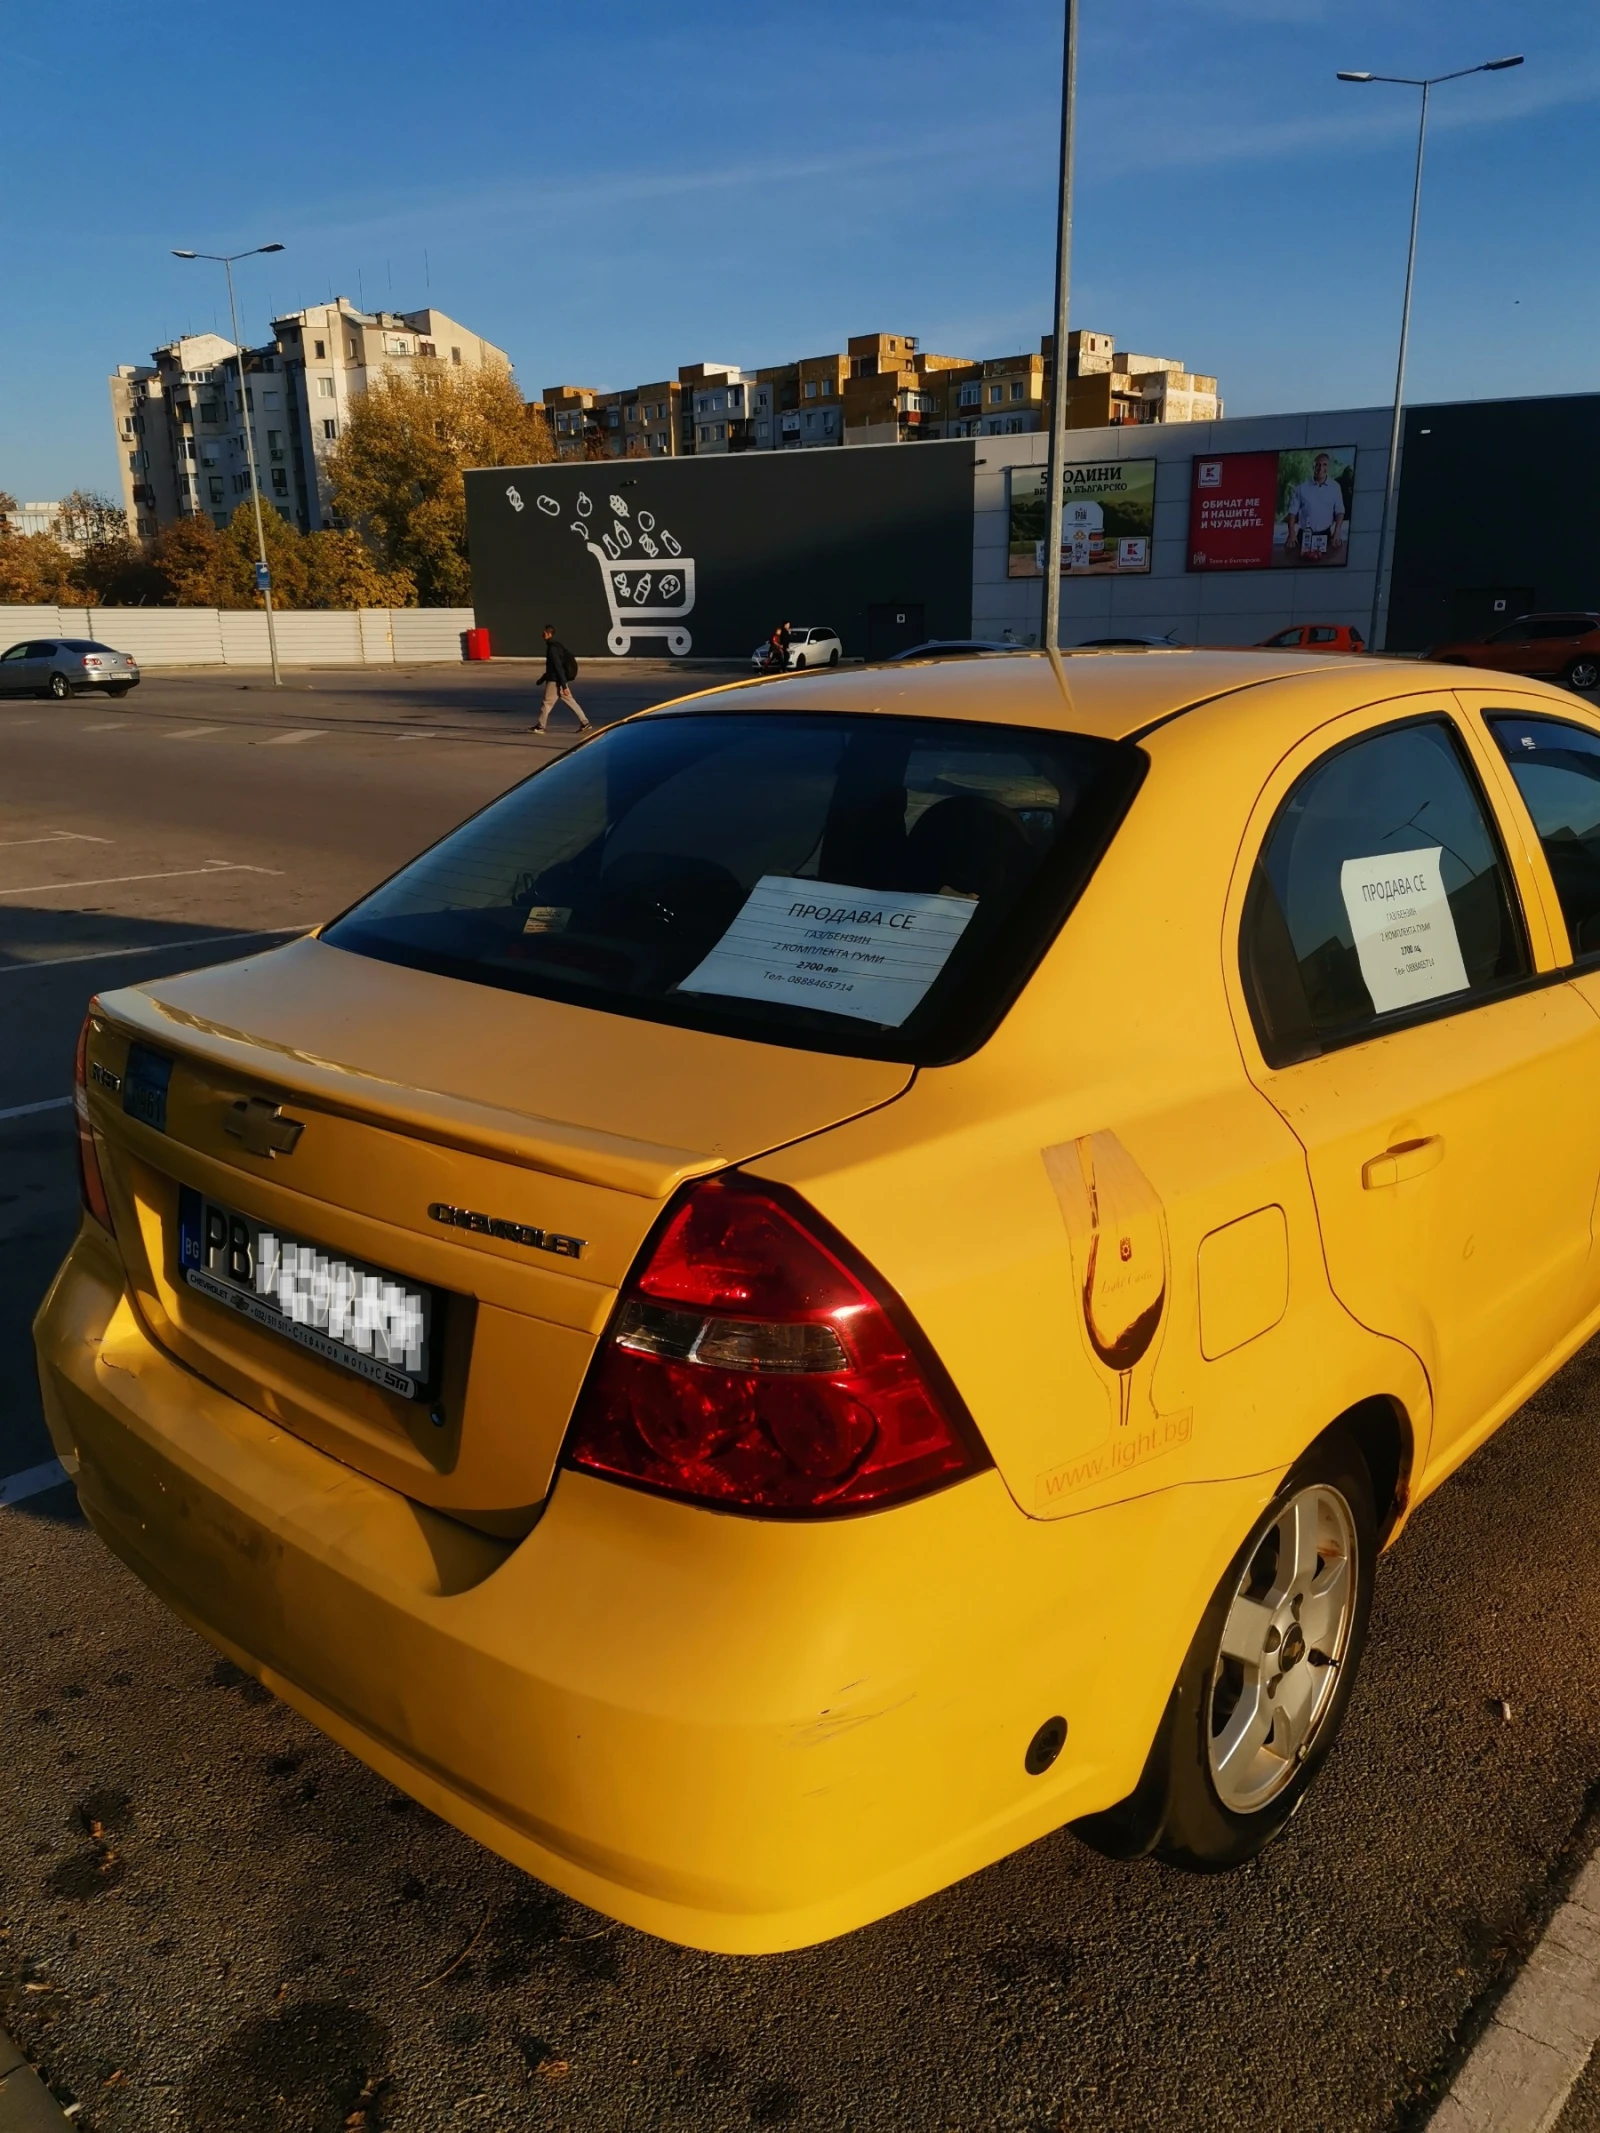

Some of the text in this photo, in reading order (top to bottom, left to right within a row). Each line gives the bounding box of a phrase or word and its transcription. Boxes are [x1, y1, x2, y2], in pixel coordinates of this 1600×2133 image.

[1063, 467, 1122, 484] ОДИНИ
[1073, 482, 1128, 494] БЪЛГАРСКО
[1201, 508, 1257, 519] И НАШИТЕ,
[1202, 498, 1260, 509] ОБИЧАТ МЕ
[1200, 518, 1264, 529] И ЧУЖДИТЕ.
[1362, 874, 1427, 902] ПРОДАВА СЕ
[788, 903, 917, 930] ПРОДАВА СЕ
[804, 930, 871, 945] ГАЗ/БЕНЗИН
[1380, 932, 1385, 941] 2
[773, 942, 885, 964] 2 КОМПЛЕКТА ГУМИ
[796, 961, 838, 974] 2700 лв
[763, 970, 854, 992] Тел- 0888465714
[429, 1203, 588, 1259] CHEVROLET
[185, 1237, 199, 1259] BG
[189, 1274, 229, 1300] CHEVROLET
[267, 1314, 277, 1329] 511
[278, 1319, 289, 1334] 511
[292, 1321, 338, 1359] СТЕФАНОВ
[1045, 1416, 1190, 1495] www.light.bg
